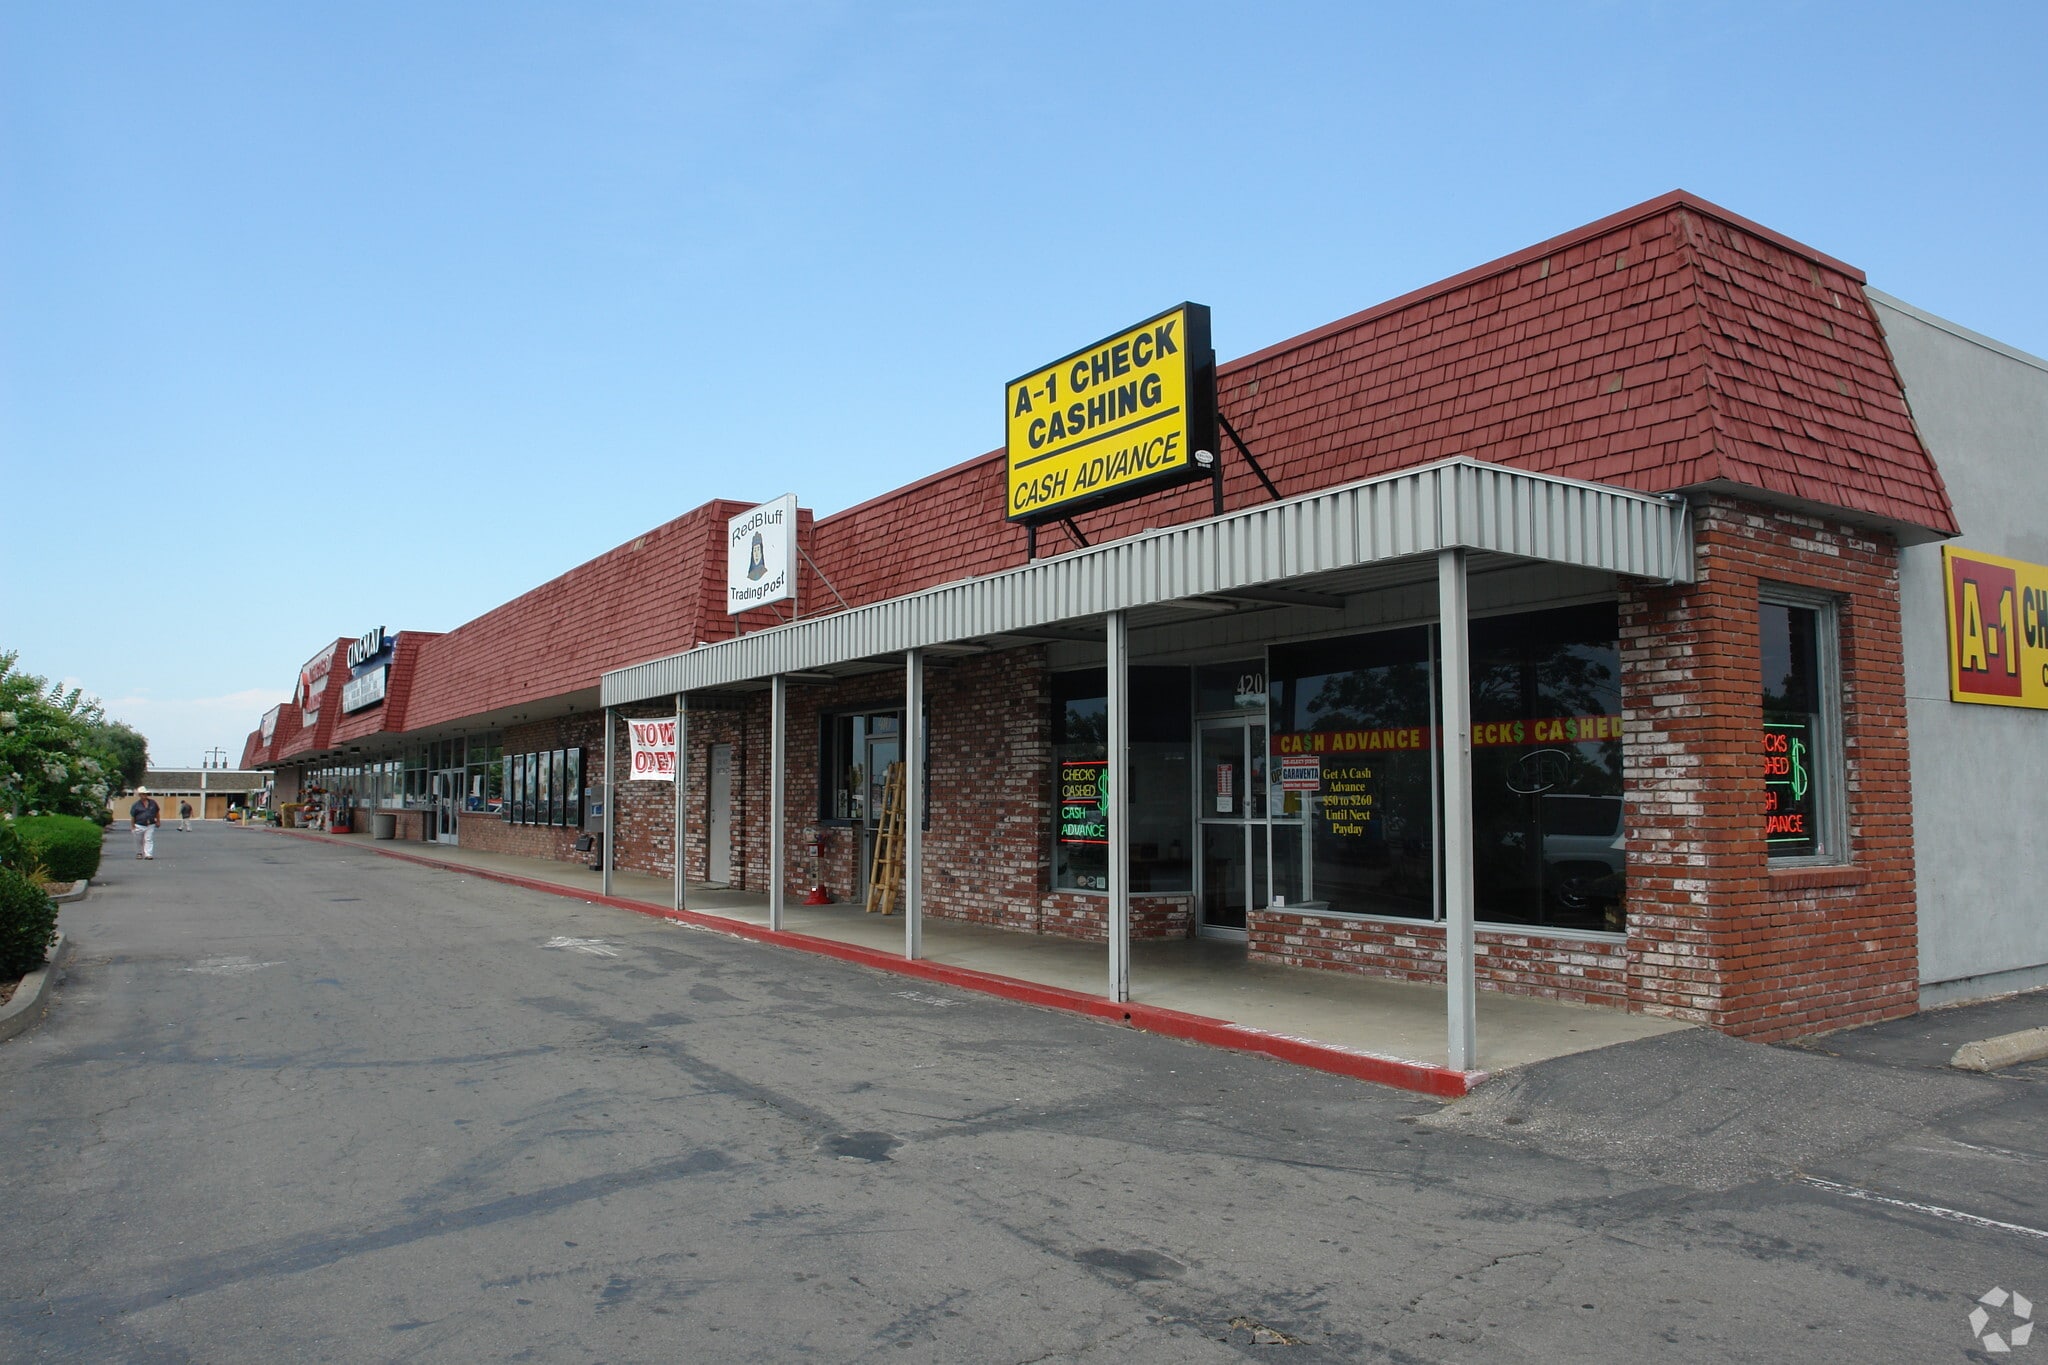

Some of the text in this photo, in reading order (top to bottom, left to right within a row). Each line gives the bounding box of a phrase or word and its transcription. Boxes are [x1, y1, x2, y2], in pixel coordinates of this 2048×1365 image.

[1014, 319, 1178, 419] A-1 CHECK
[1028, 372, 1162, 450] CASHING
[1013, 431, 1181, 511] CASH ADVANCE
[1961, 577, 2018, 677] A-1
[1237, 673, 1263, 695] 420
[633, 722, 676, 747] NOW
[1332, 729, 1420, 750] ADVANCE
[1762, 733, 1788, 753] CKS
[1062, 768, 1096, 781] CHECKS
[1283, 767, 1318, 780] GARAVENTA
[1322, 767, 1372, 779] Get A Cash
[1062, 784, 1096, 797] CASHED
[1329, 781, 1366, 792] Advance
[1322, 794, 1372, 806] $50 to $260
[1061, 806, 1086, 819] CASH
[1325, 809, 1371, 820] Until Next
[1061, 823, 1106, 837] ADVANCE
[1332, 822, 1364, 836] Payday
